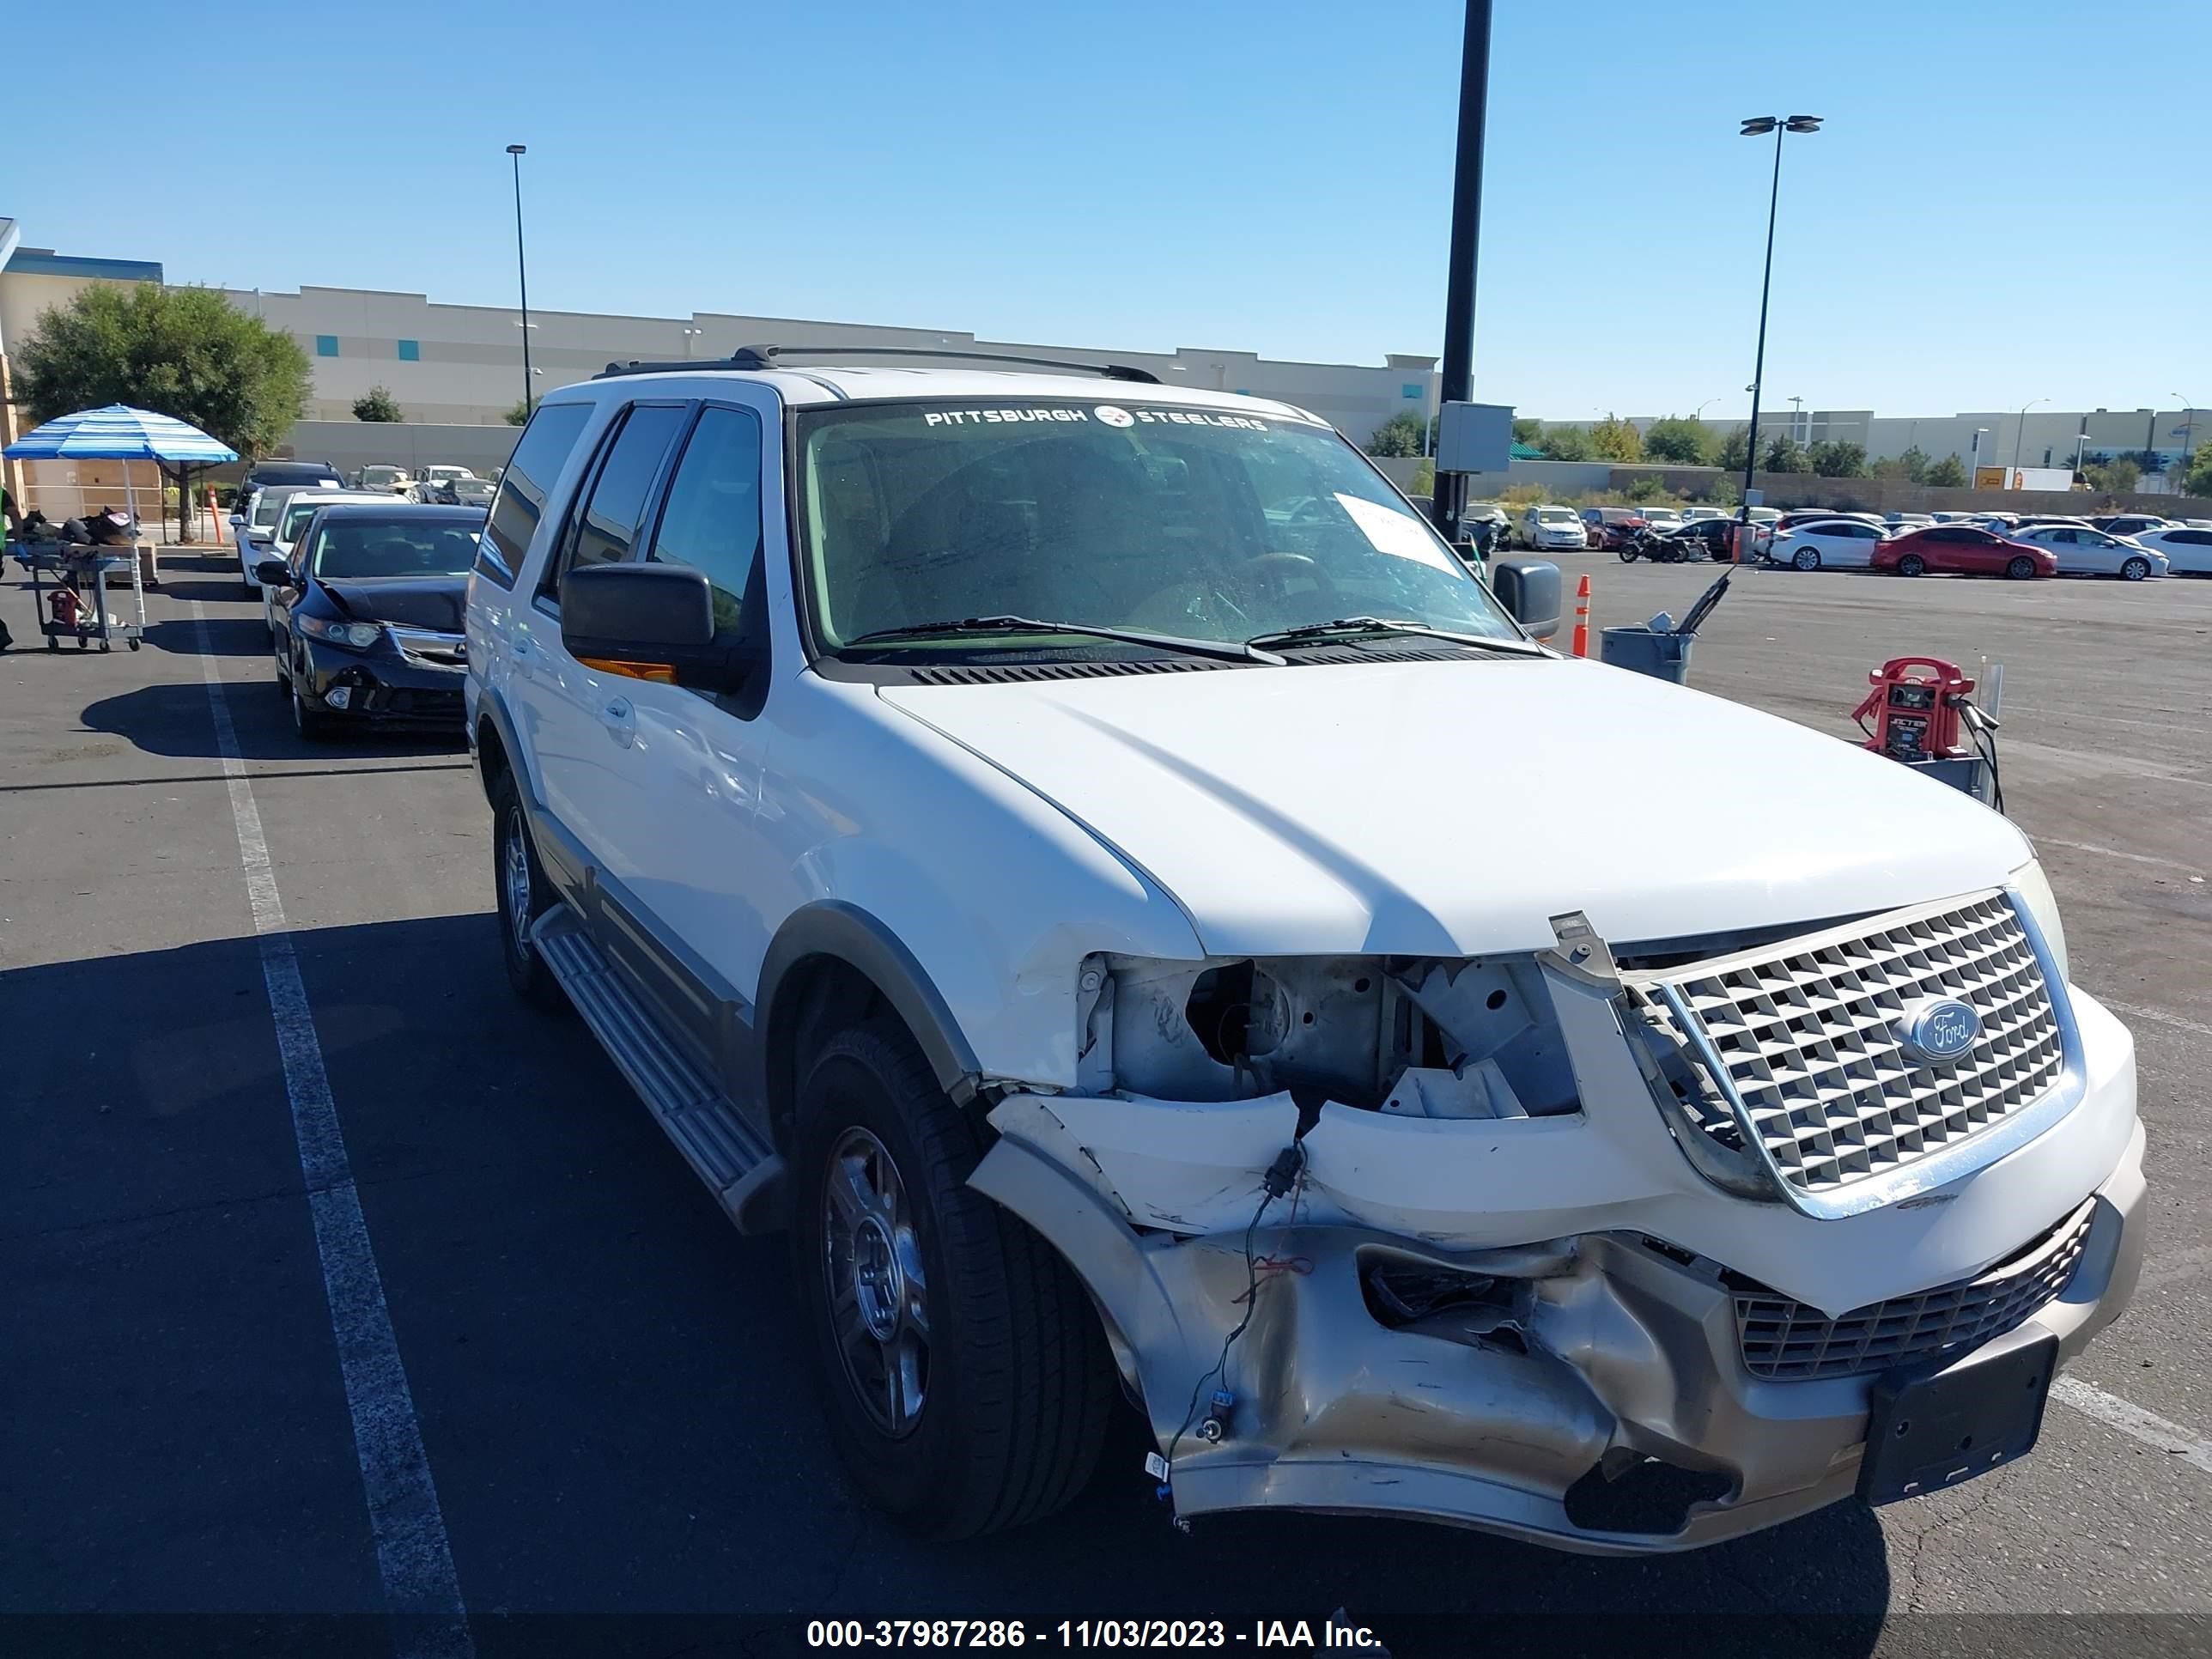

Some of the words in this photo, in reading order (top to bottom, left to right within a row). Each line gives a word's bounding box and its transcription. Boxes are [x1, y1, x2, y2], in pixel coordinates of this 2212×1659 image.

[924, 410, 1089, 427] PITTSBURGH
[1135, 410, 1269, 432] STEELERS
[1933, 1012, 1969, 1048] Ford
